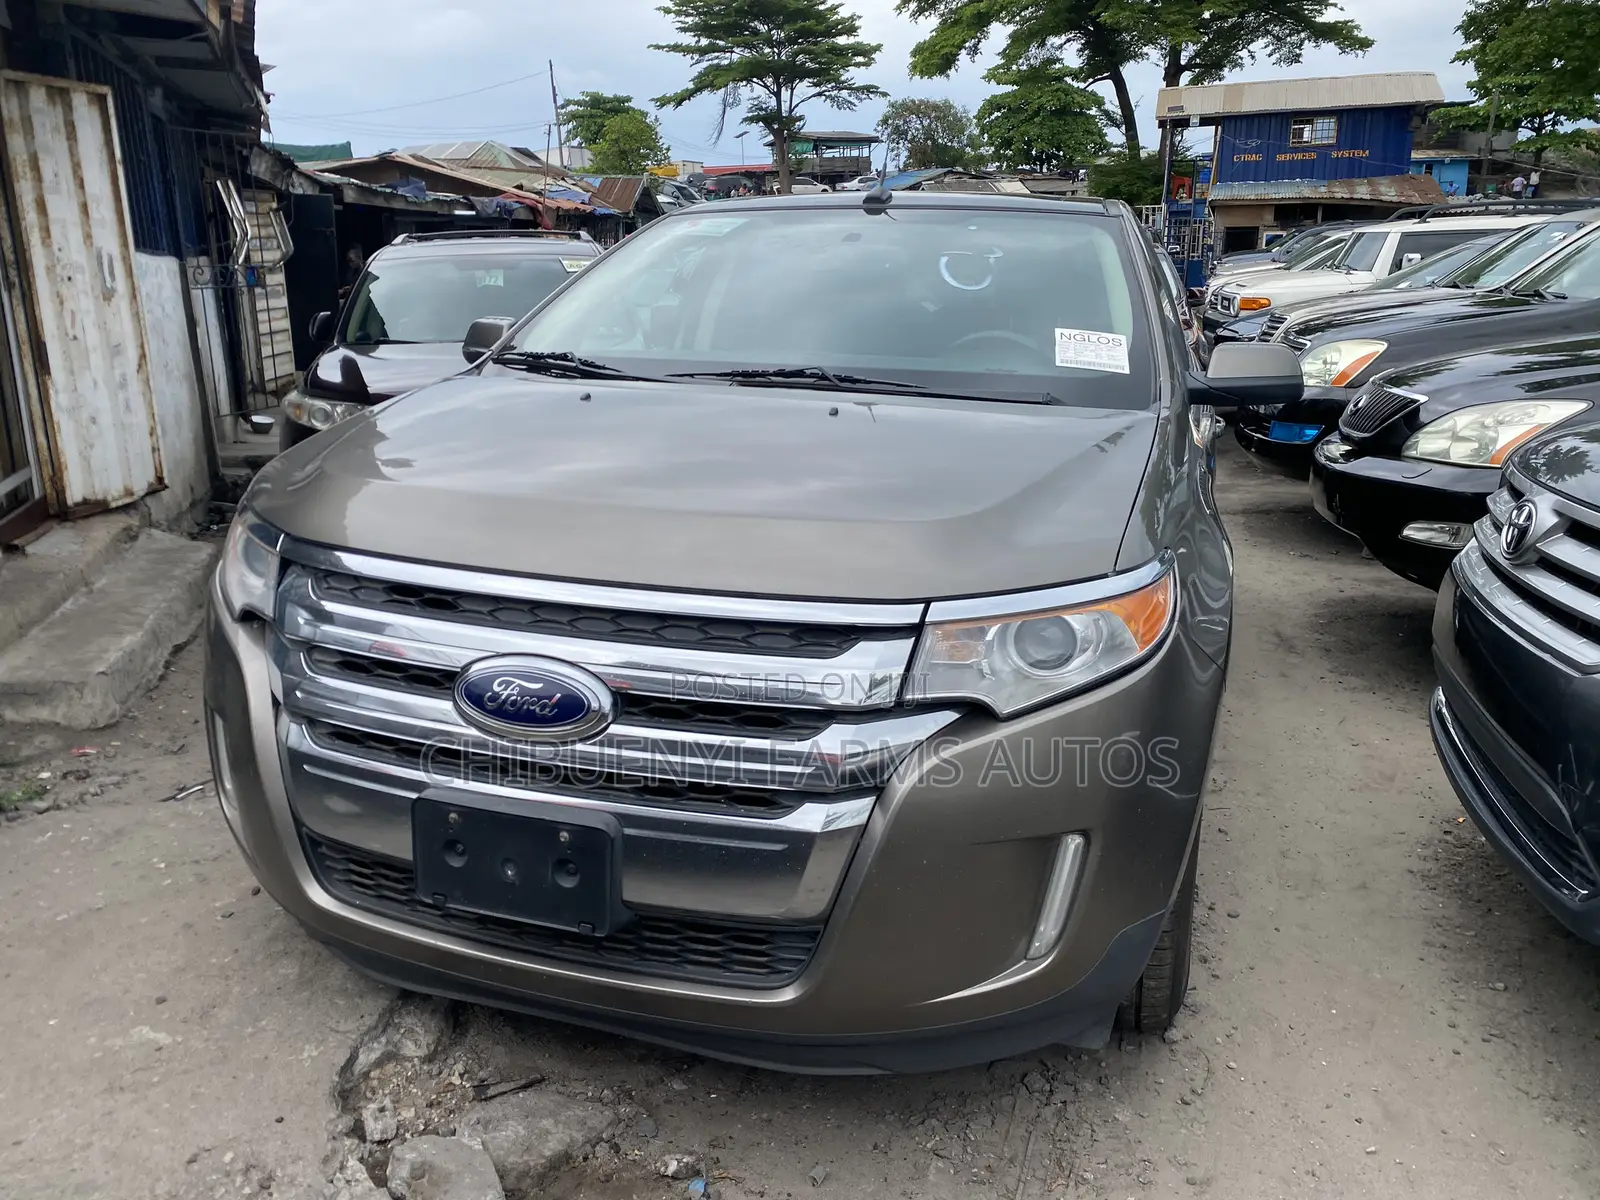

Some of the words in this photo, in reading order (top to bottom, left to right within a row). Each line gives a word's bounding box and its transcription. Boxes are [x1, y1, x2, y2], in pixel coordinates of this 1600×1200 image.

[1233, 153, 1263, 162] CTRAC
[1276, 152, 1317, 161] SERVICES
[1331, 149, 1370, 158] SYSTEM
[1060, 332, 1123, 347] NGLOS
[484, 676, 561, 715] Ford
